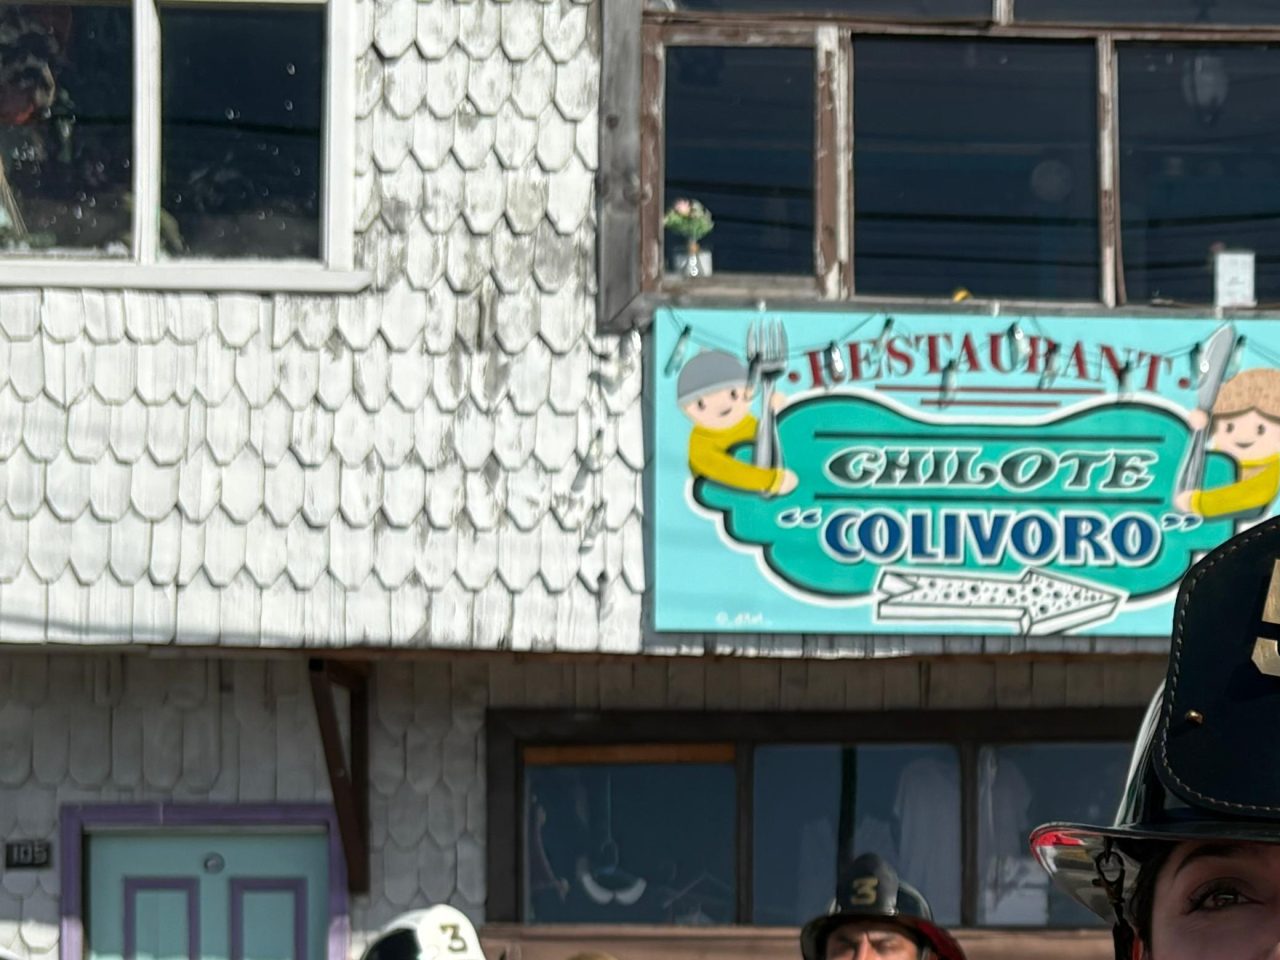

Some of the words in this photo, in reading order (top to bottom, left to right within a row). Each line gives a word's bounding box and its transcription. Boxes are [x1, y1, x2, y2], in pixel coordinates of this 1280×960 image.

[826, 446, 1160, 491] CHILOTE
[851, 878, 878, 905] 3
[440, 924, 468, 952] 3
